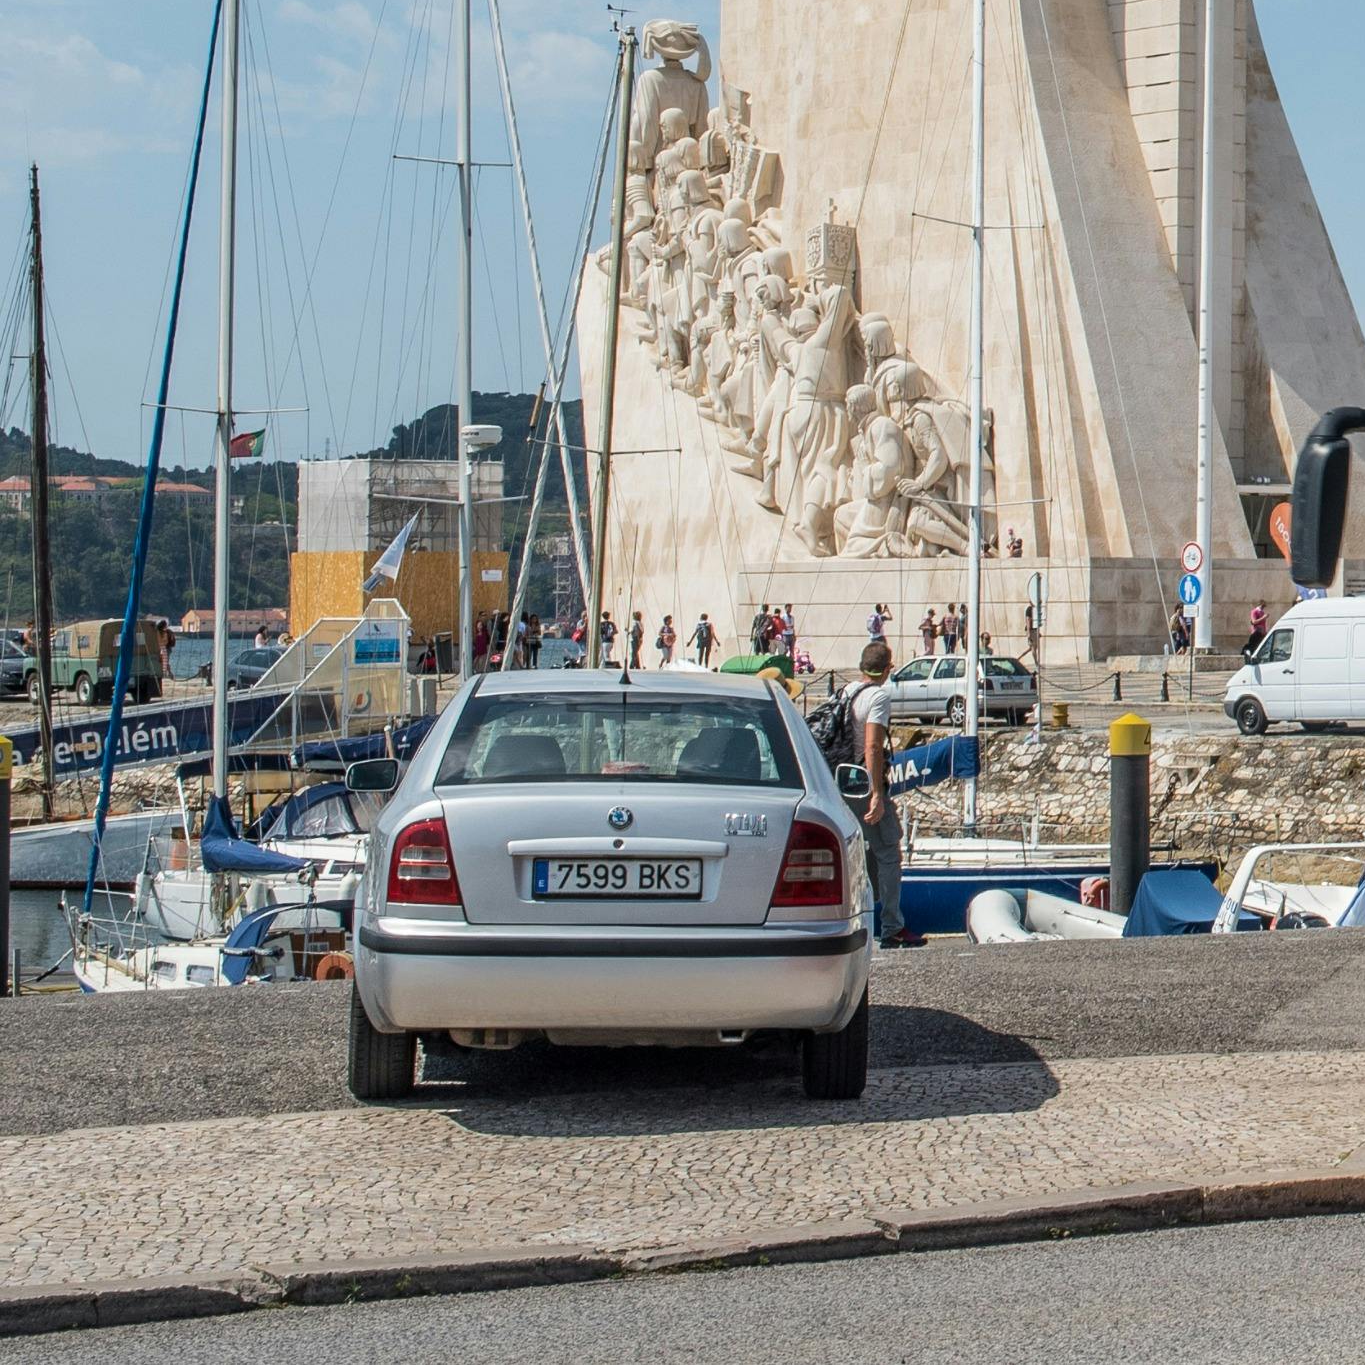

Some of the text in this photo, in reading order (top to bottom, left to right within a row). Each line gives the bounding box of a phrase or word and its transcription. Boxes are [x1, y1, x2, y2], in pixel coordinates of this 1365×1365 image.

[81, 722, 178, 760] Blém
[557, 864, 628, 890] 7599
[638, 864, 690, 889] BKS
